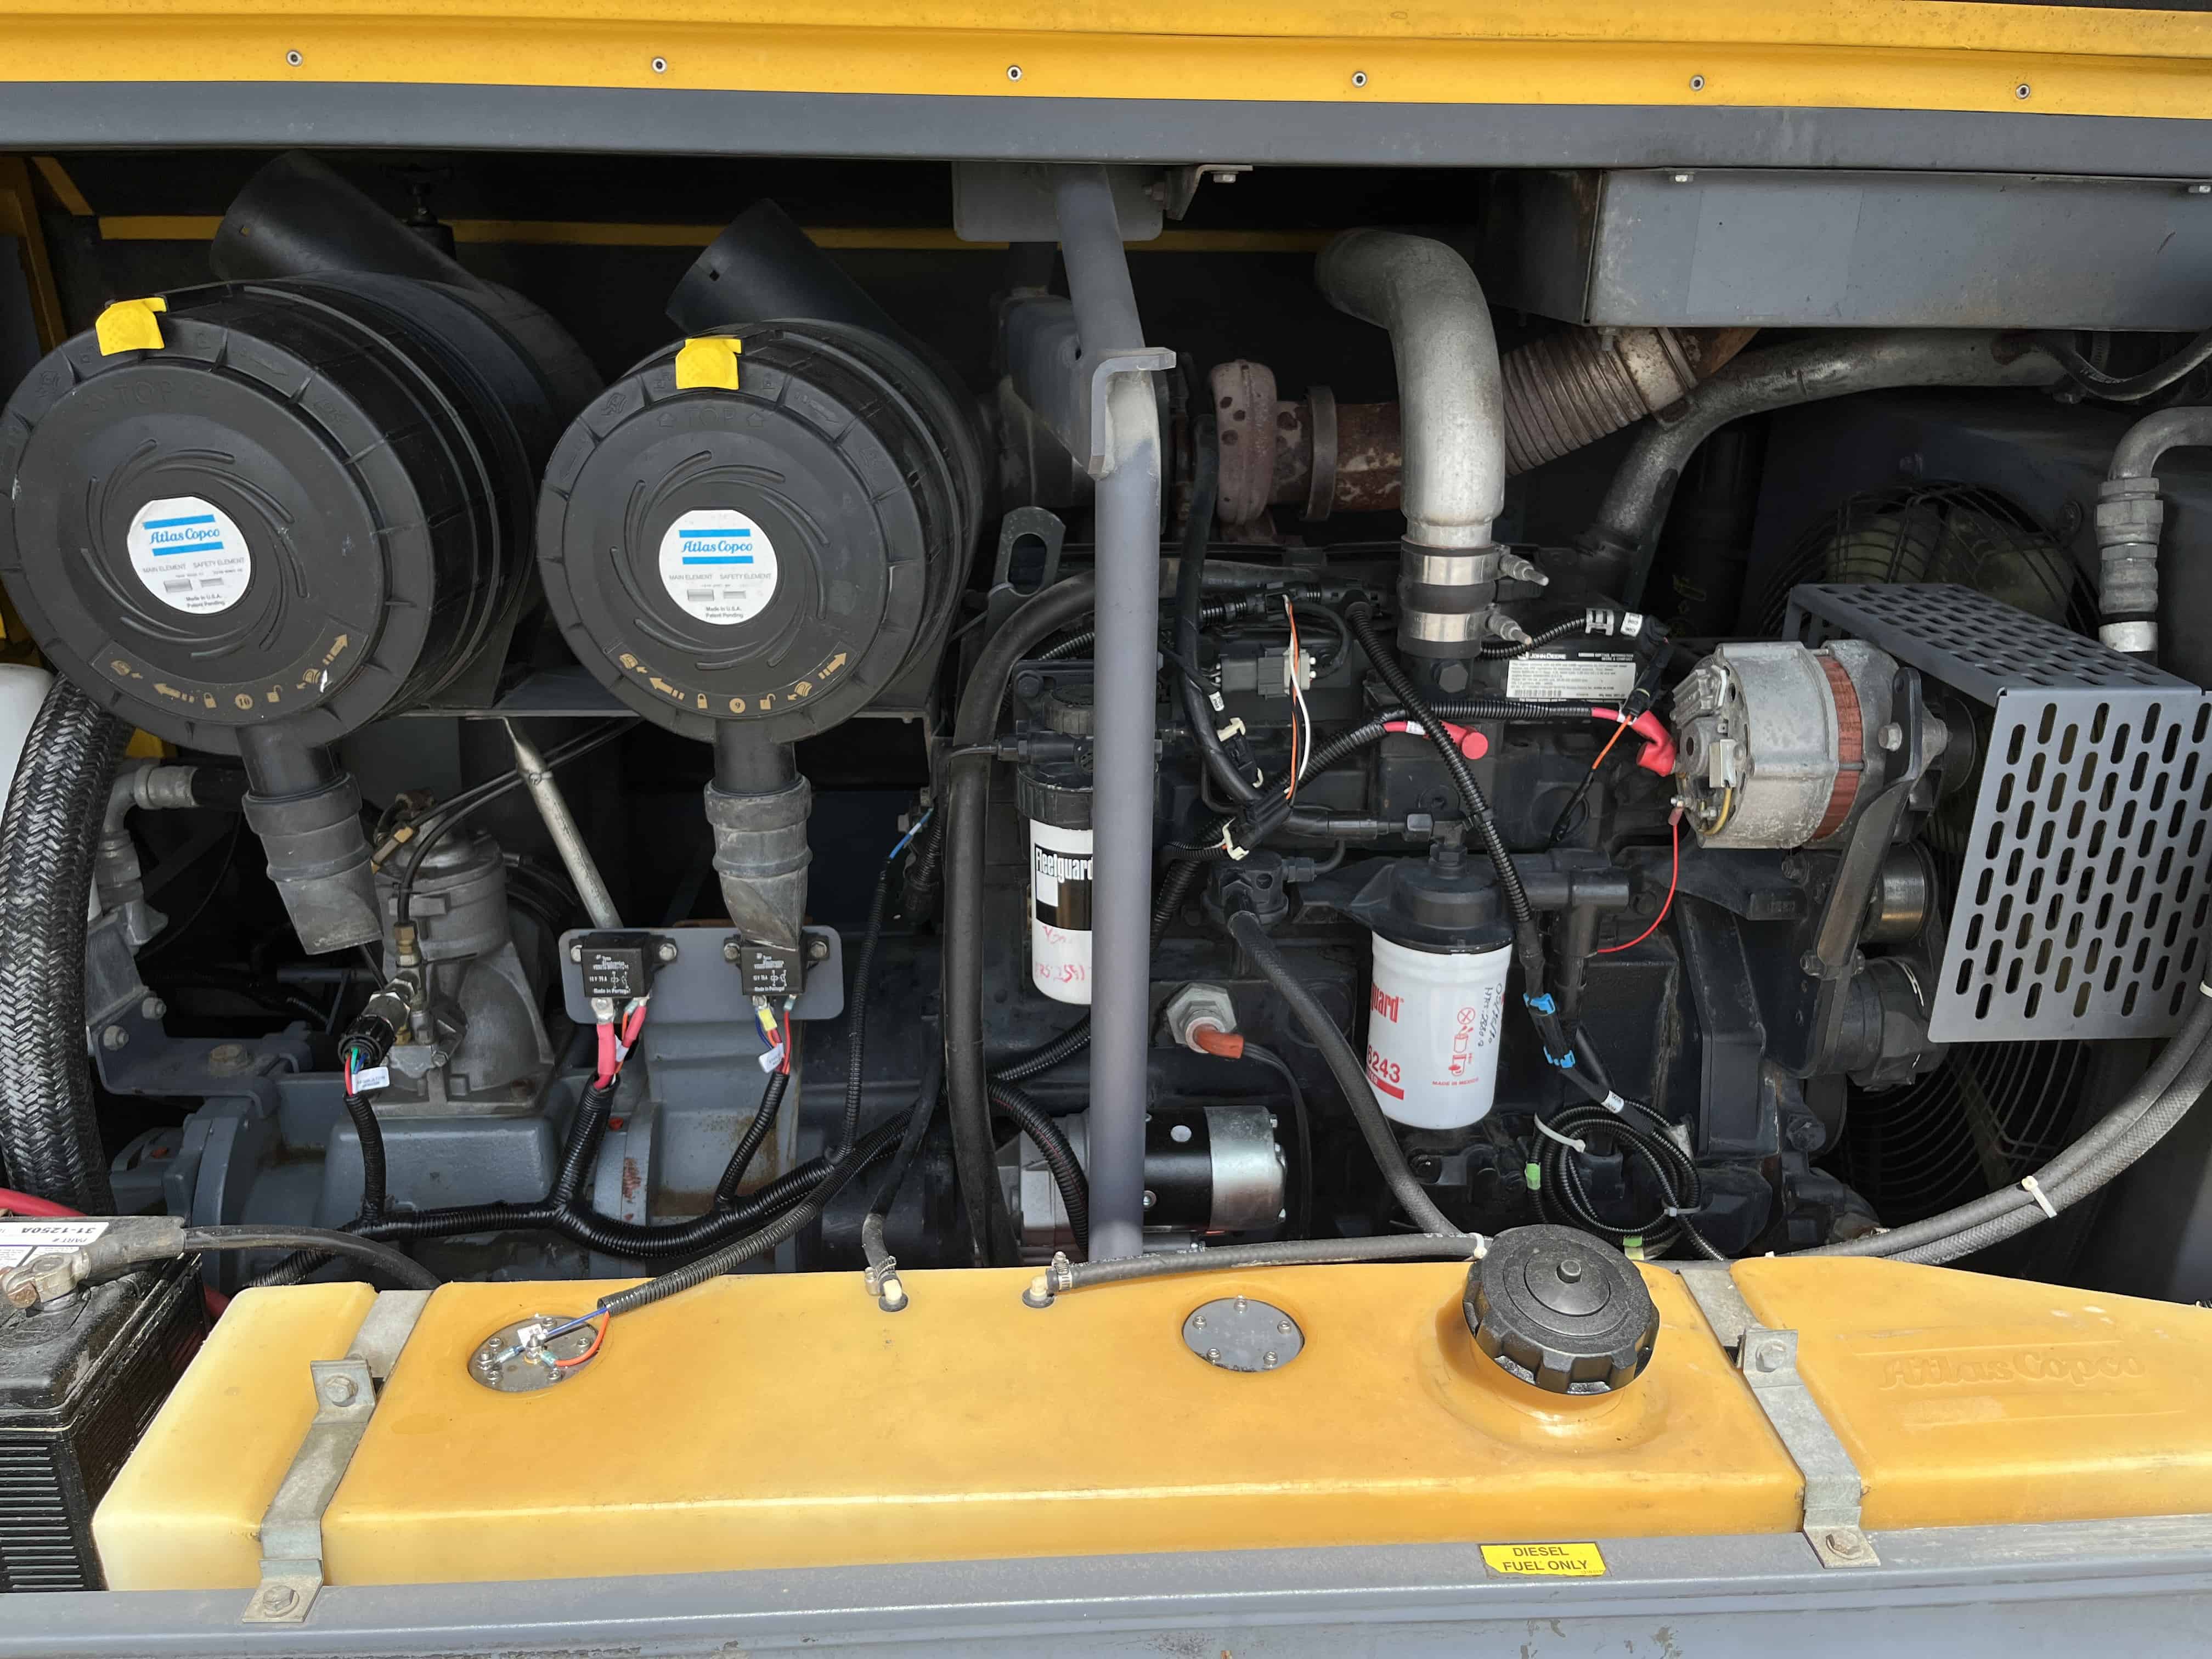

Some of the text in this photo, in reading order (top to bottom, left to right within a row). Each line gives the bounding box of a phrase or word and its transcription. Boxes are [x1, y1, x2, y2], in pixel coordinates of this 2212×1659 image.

[149, 528, 220, 545] Atlas Copco
[681, 540, 753, 554] Atlas Copco
[159, 563, 187, 572] ELEMENT
[193, 560, 216, 568] SAFETY
[217, 557, 245, 566] ELEMENT
[239, 697, 250, 707] 10
[1513, 1546, 1570, 1556] DIESEL
[1503, 1560, 1588, 1571] FUEL ONLY
